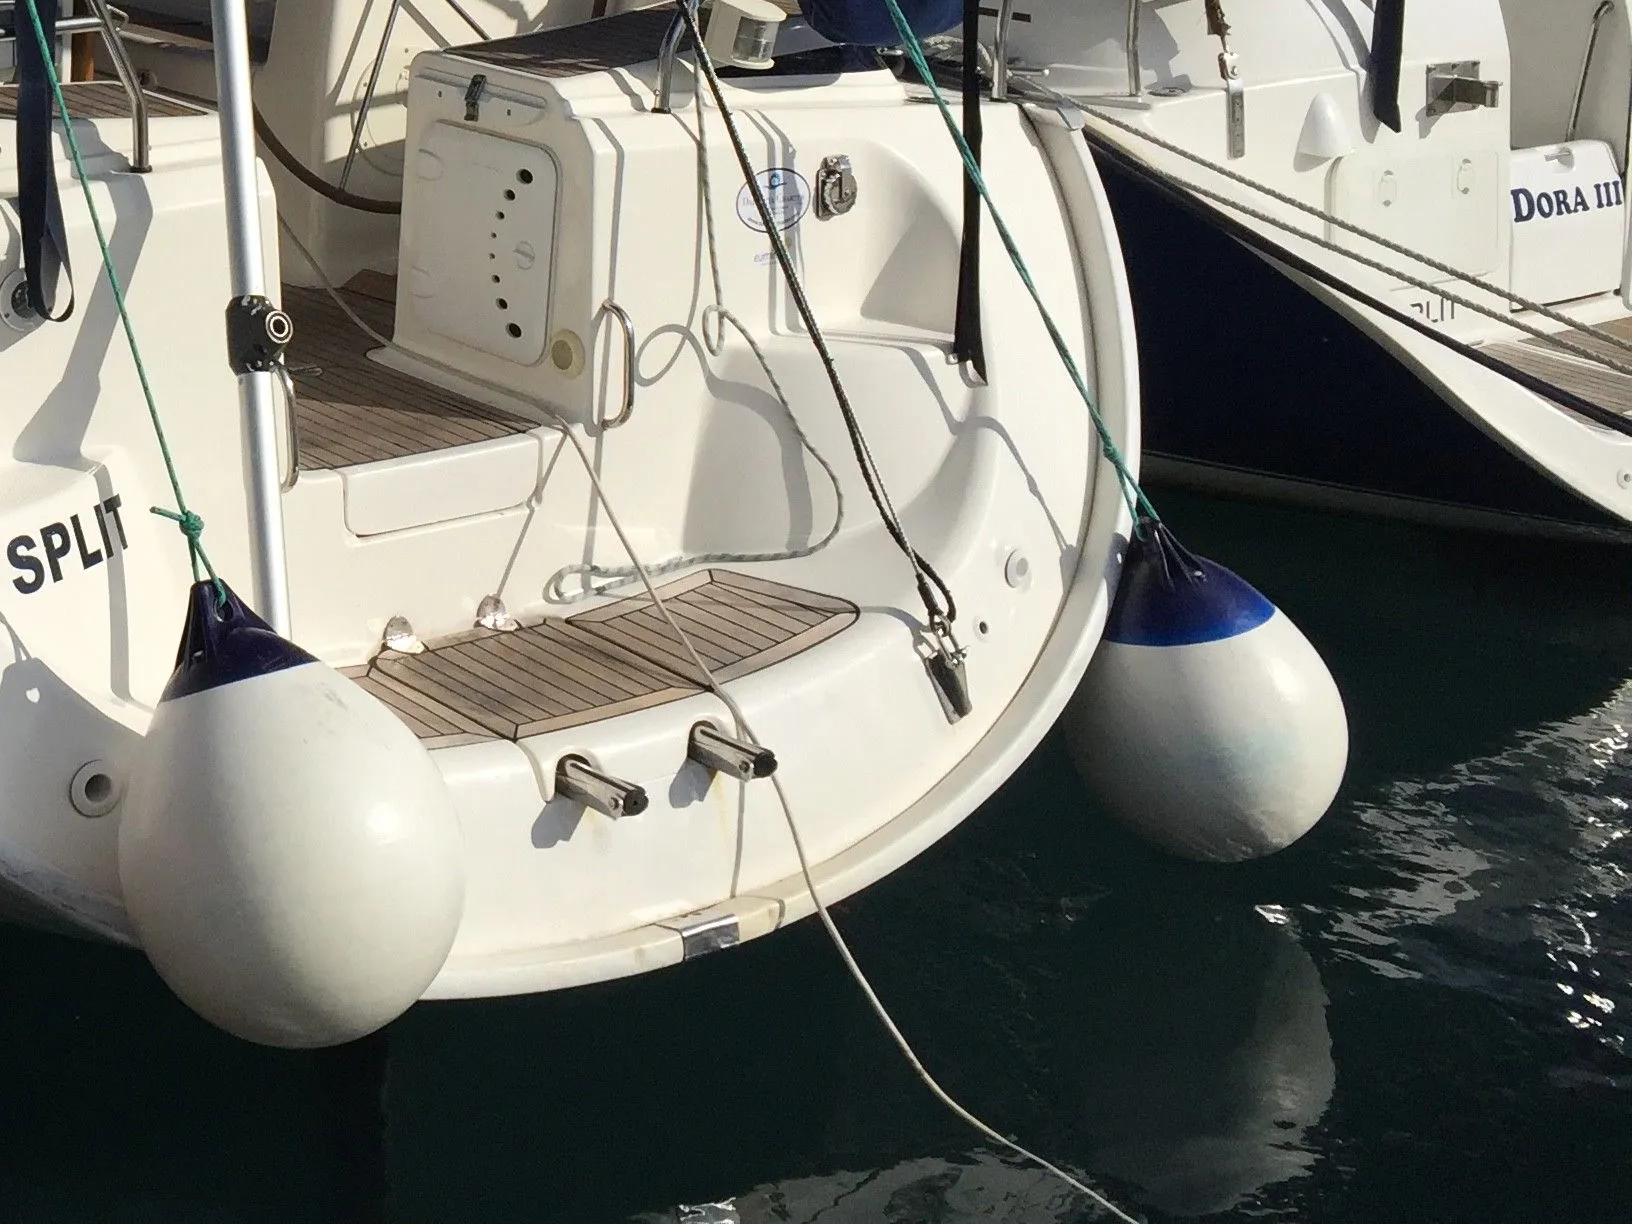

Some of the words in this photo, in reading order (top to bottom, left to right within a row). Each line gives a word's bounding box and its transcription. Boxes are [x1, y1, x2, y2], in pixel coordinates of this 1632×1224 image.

[1510, 186, 1590, 223] DORA
[1593, 180, 1623, 209] III
[6, 493, 129, 595] SPLIT
